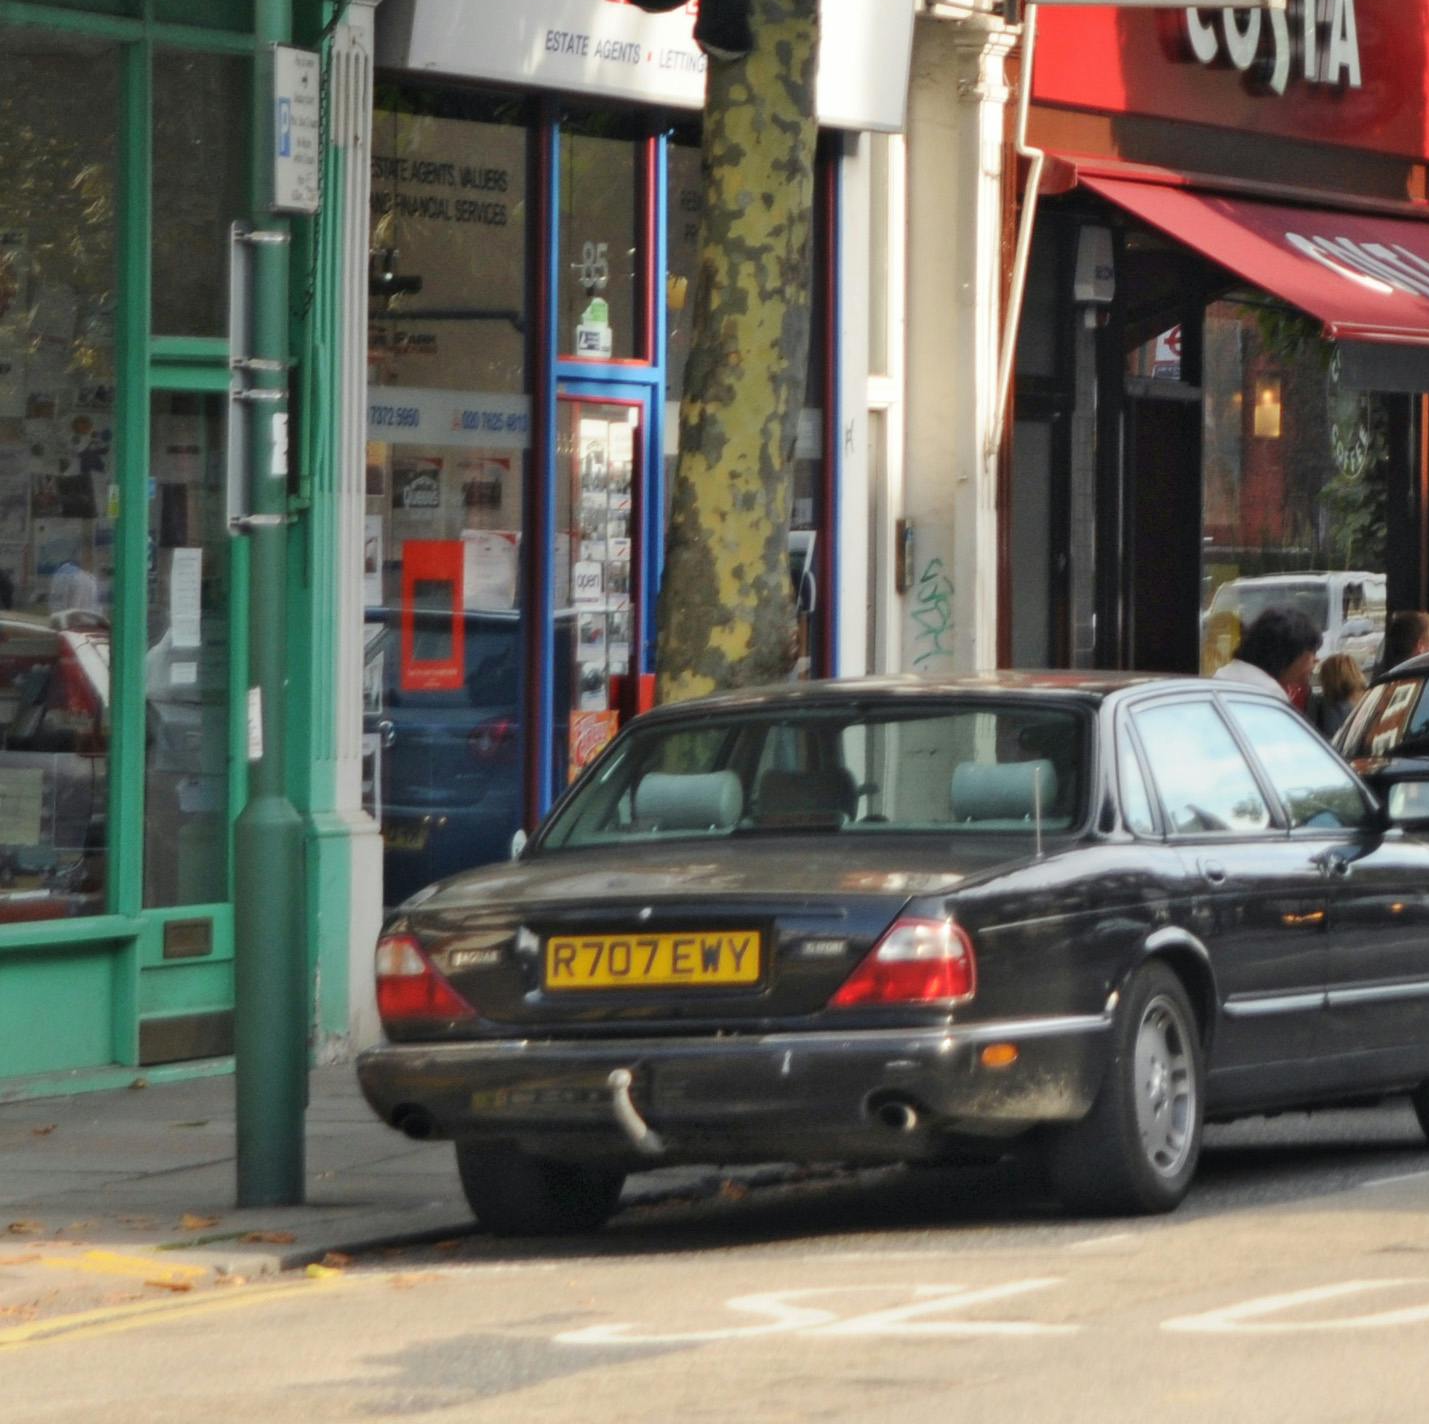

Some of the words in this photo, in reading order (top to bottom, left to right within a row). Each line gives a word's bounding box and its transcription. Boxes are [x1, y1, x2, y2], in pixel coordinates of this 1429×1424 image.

[545, 30, 589, 57] ESTATE
[595, 38, 641, 67] AGENTS
[456, 200, 508, 228] SERVICES
[581, 240, 609, 289] 85
[577, 573, 601, 592] open
[552, 941, 661, 978] R707
[671, 938, 753, 976] EWY
